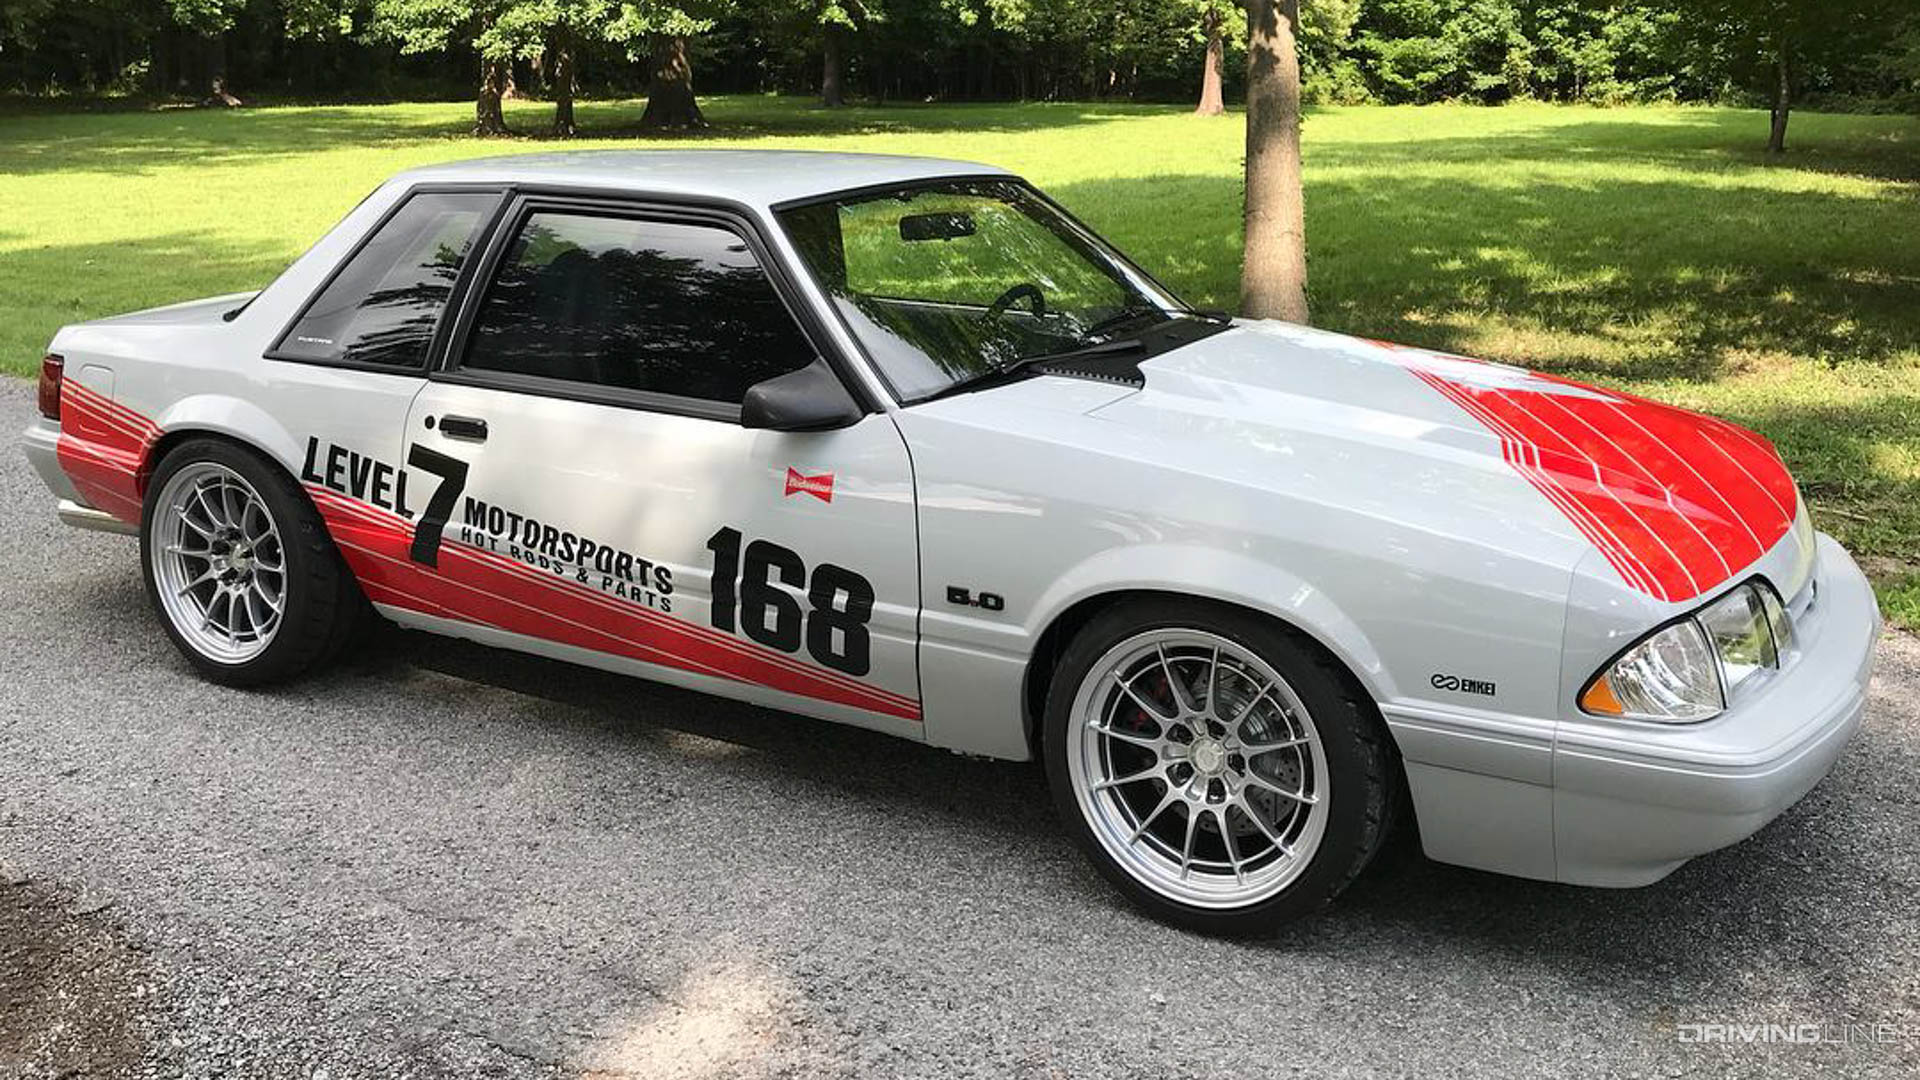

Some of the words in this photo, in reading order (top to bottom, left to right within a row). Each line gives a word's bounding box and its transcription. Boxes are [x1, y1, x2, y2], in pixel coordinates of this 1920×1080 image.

[302, 437, 414, 519] LEVEL
[407, 442, 469, 569] 7
[465, 497, 674, 595] MOTORSPORTS
[461, 527, 500, 549] HOT
[510, 545, 563, 576] RODS
[576, 568, 590, 584] &
[602, 576, 672, 612] PARTS
[707, 526, 875, 676] 168
[947, 585, 1004, 611] 5.0
[1461, 679, 1496, 696] ENKEI
